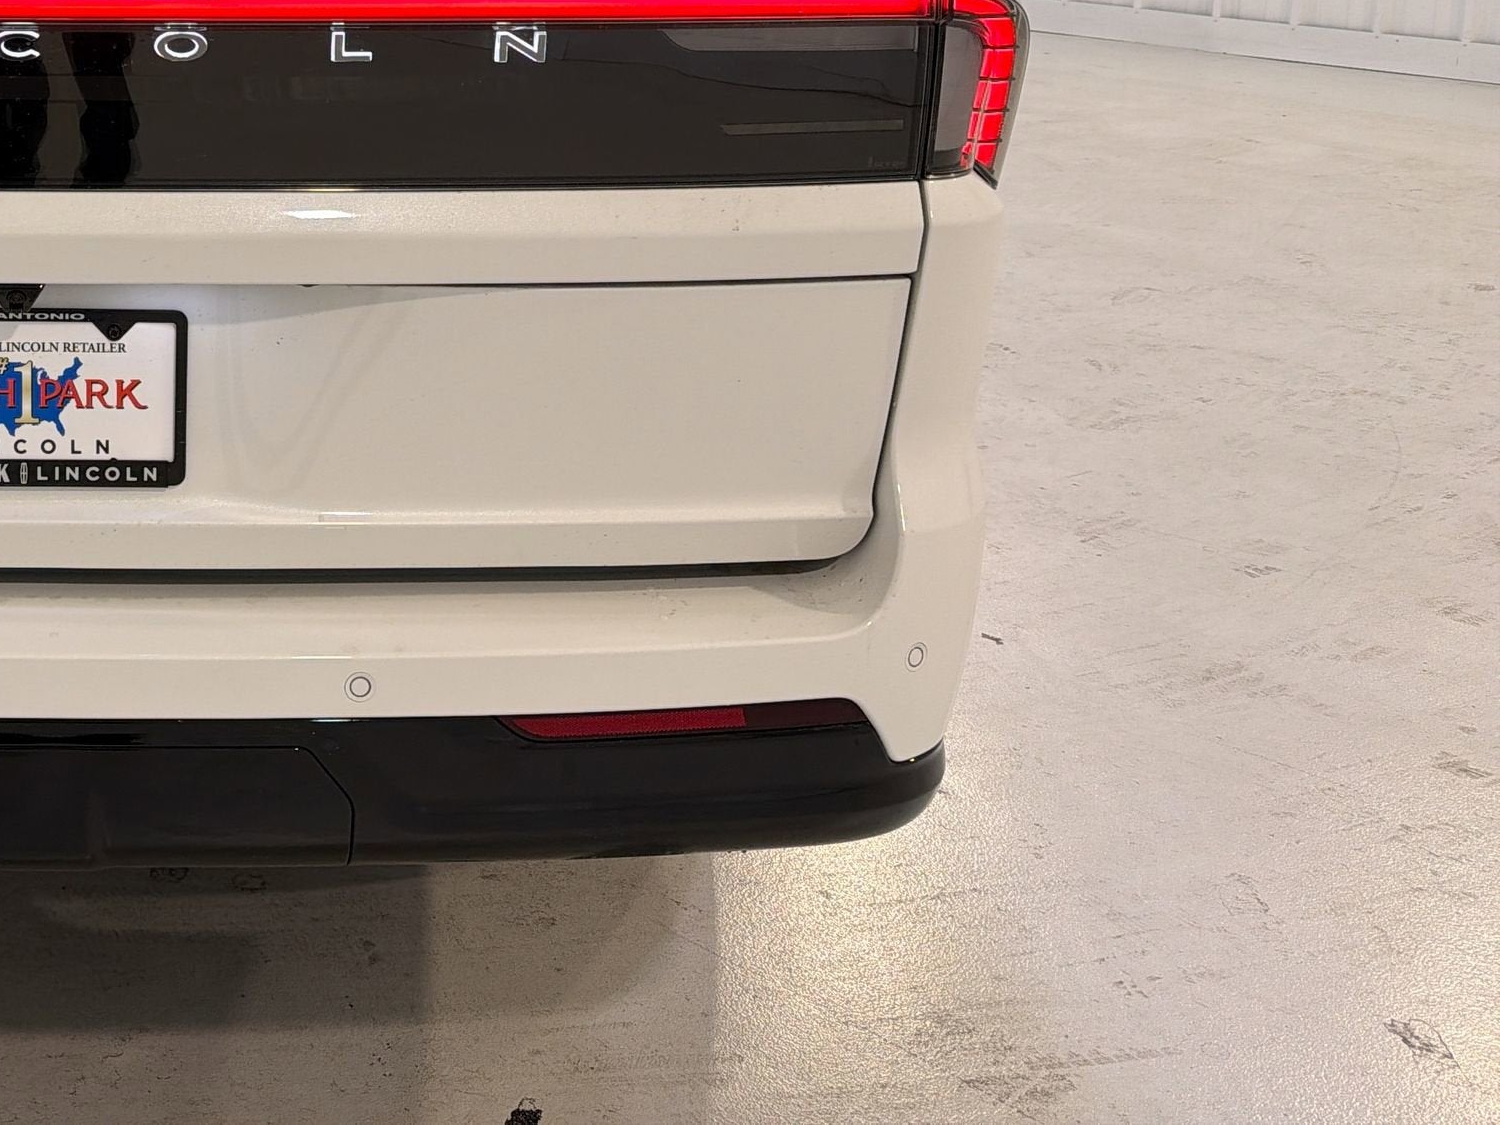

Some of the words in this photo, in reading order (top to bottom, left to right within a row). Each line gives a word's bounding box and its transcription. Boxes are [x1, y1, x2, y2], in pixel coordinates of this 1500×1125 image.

[63, 342, 127, 353] RETAILER
[39, 378, 148, 409] PARK
[37, 466, 158, 482] LINCOLN
